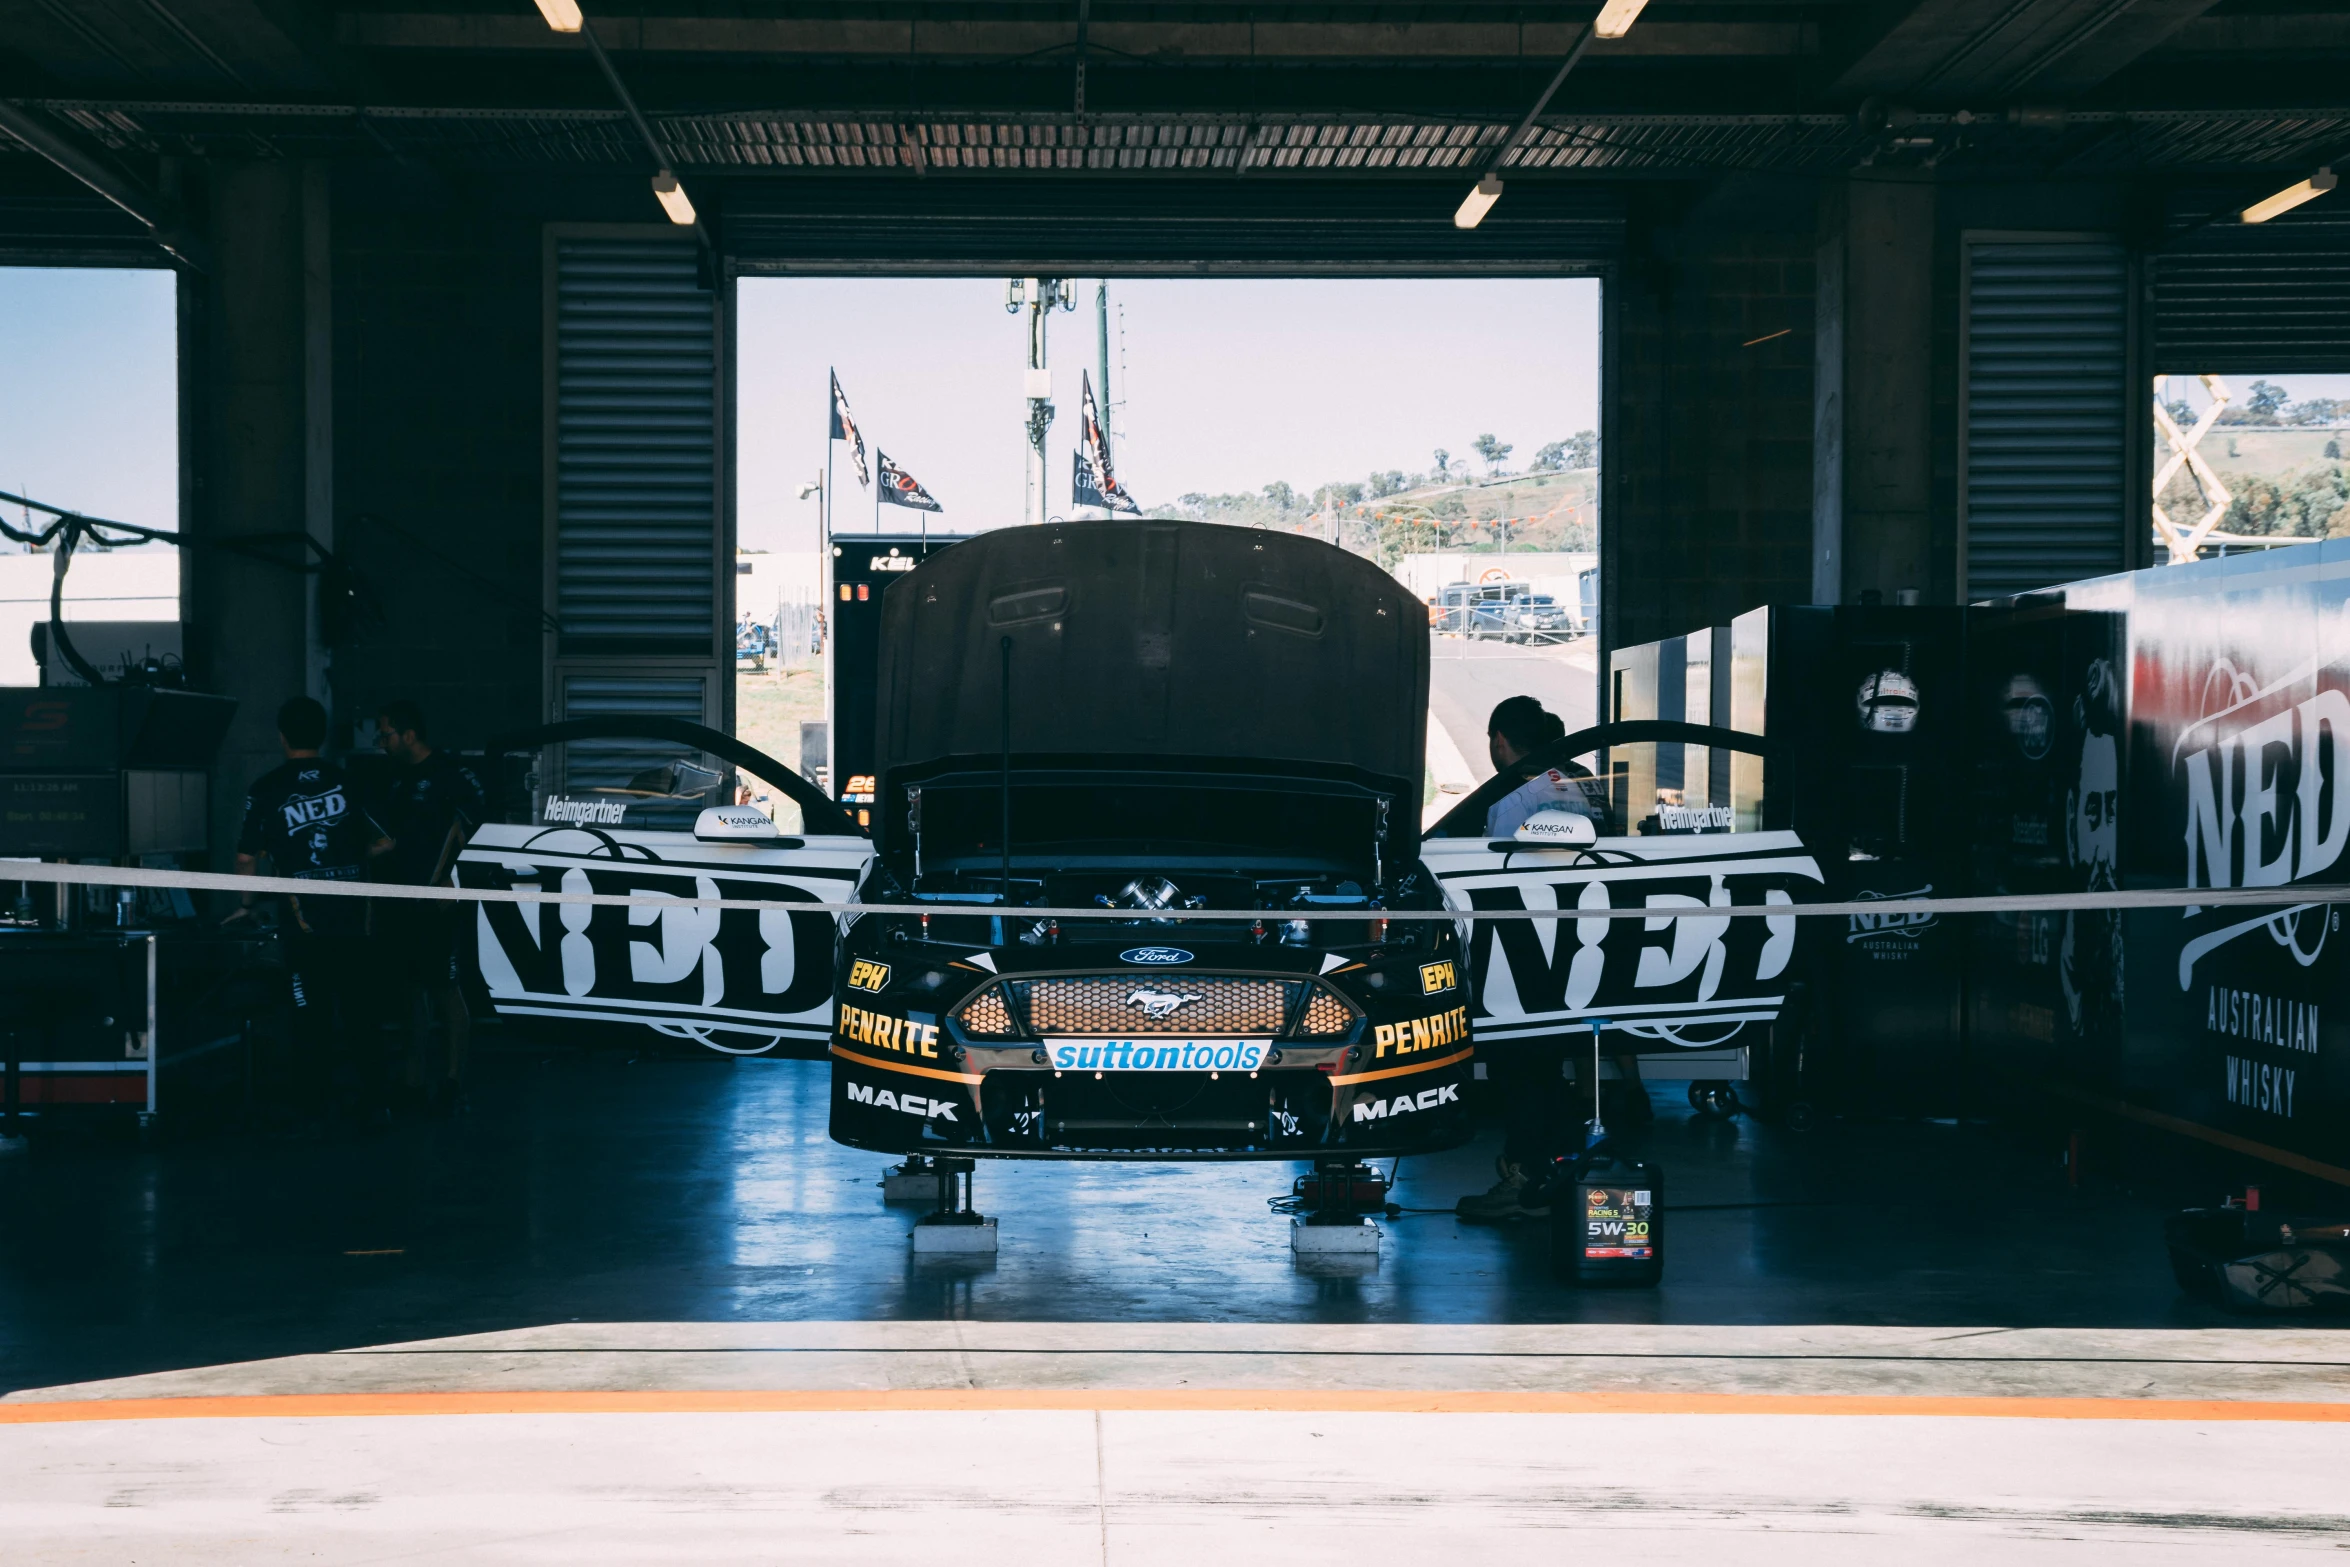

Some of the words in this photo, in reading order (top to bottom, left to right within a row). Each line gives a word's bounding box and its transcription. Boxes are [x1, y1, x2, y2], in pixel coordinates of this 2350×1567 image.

[283, 793, 348, 828] NED
[543, 795, 627, 827] Heimgartner
[730, 817, 772, 826] KANGAN
[2182, 689, 2350, 919] NED
[1531, 824, 1574, 835] KANGAN
[1848, 896, 1934, 932] NED
[456, 861, 838, 1014] NED
[1464, 876, 1815, 1017] NED
[1862, 941, 1920, 950] AUSTRALIAN
[1134, 949, 1179, 962] Ford
[1873, 952, 1909, 960] WHISKY
[850, 961, 888, 991] EPH
[1421, 962, 1456, 993] EPH
[840, 1003, 940, 1059] PENRITE
[1374, 1005, 1468, 1059] PENRITE
[2207, 985, 2319, 1054] AUSTRALIAN
[847, 1081, 959, 1122] MACK
[1353, 1083, 1459, 1123] MACK
[2226, 1055, 2295, 1118] WHISKY
[1587, 1221, 1649, 1236] 5W-30
